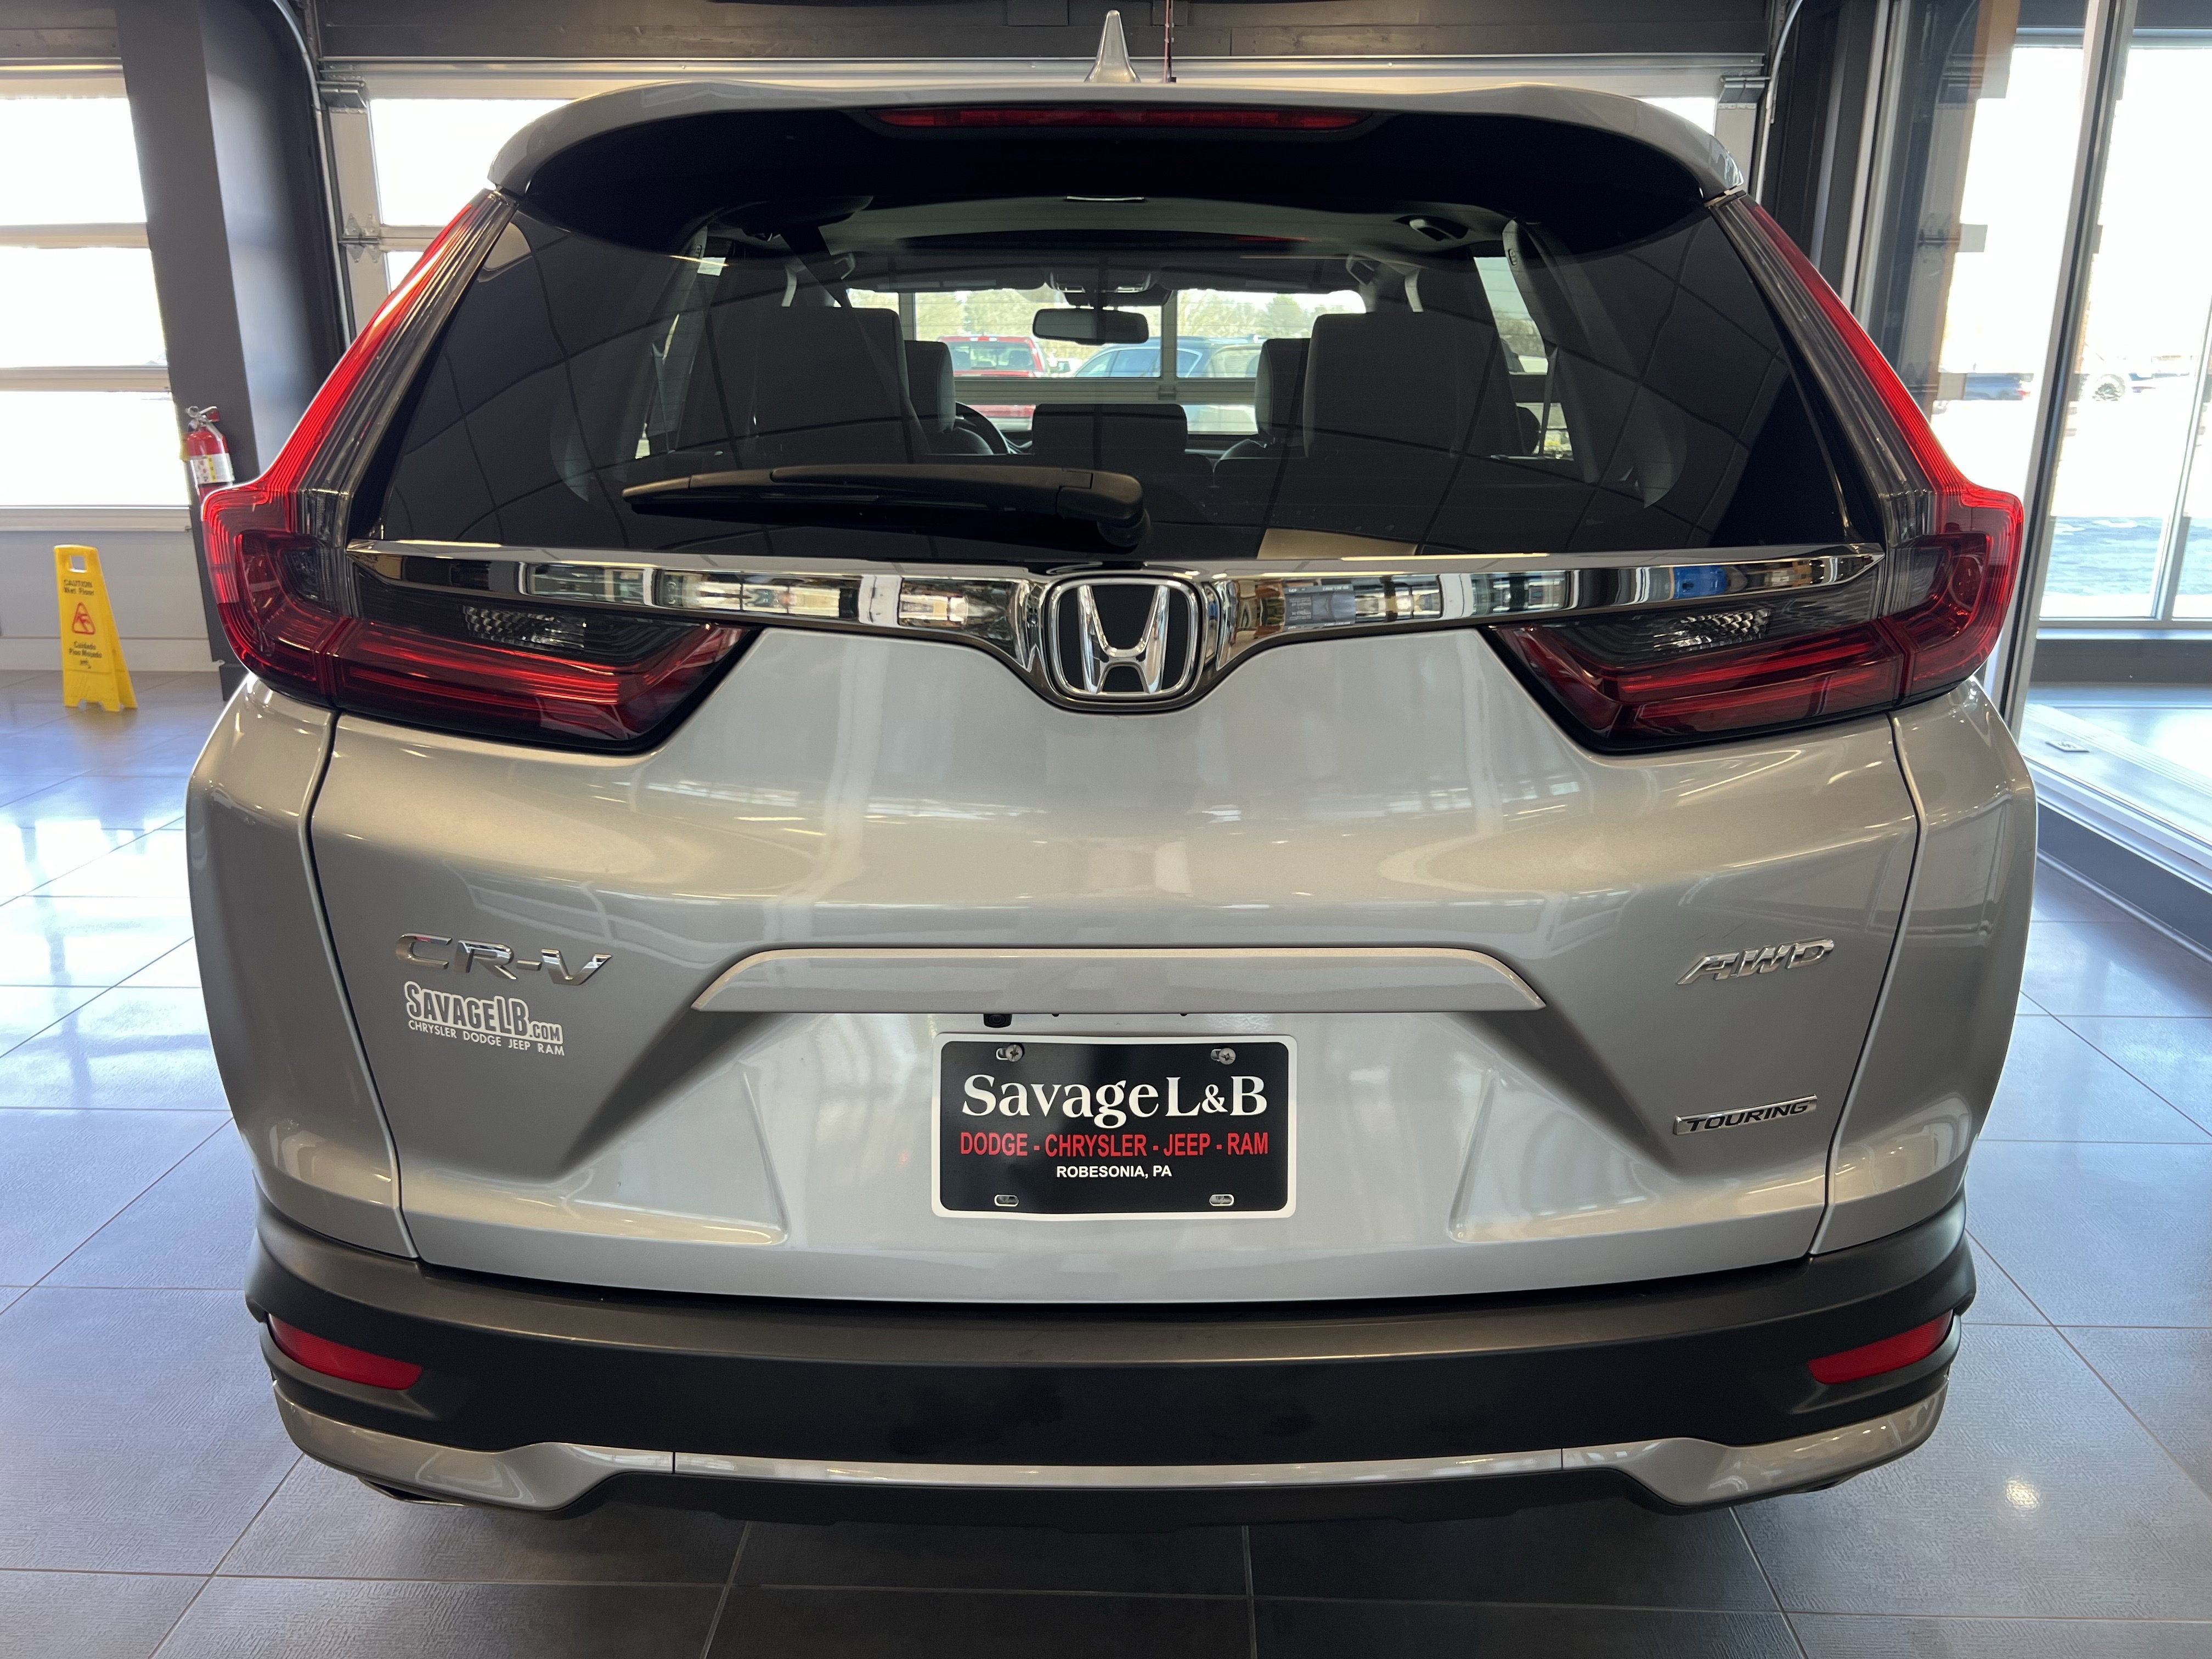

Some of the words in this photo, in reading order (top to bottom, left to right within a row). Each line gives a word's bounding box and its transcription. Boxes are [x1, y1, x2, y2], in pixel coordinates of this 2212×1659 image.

[395, 933, 613, 986] CR-V
[1675, 936, 1835, 985] AWD
[408, 1019, 457, 1039] CHRYSLER
[463, 1030, 501, 1047] DODGE
[508, 1039, 531, 1051] JEEP
[537, 1043, 565, 1056] RAM
[1686, 1101, 1810, 1132] TOURING
[961, 1132, 1028, 1156] DODGE
[1045, 1133, 1147, 1157] CHRYSLER
[1163, 1133, 1210, 1156] JEEP
[1227, 1132, 1268, 1155] RAM
[1057, 1165, 1148, 1178] ROBESONIA,
[1153, 1165, 1172, 1177] PA
